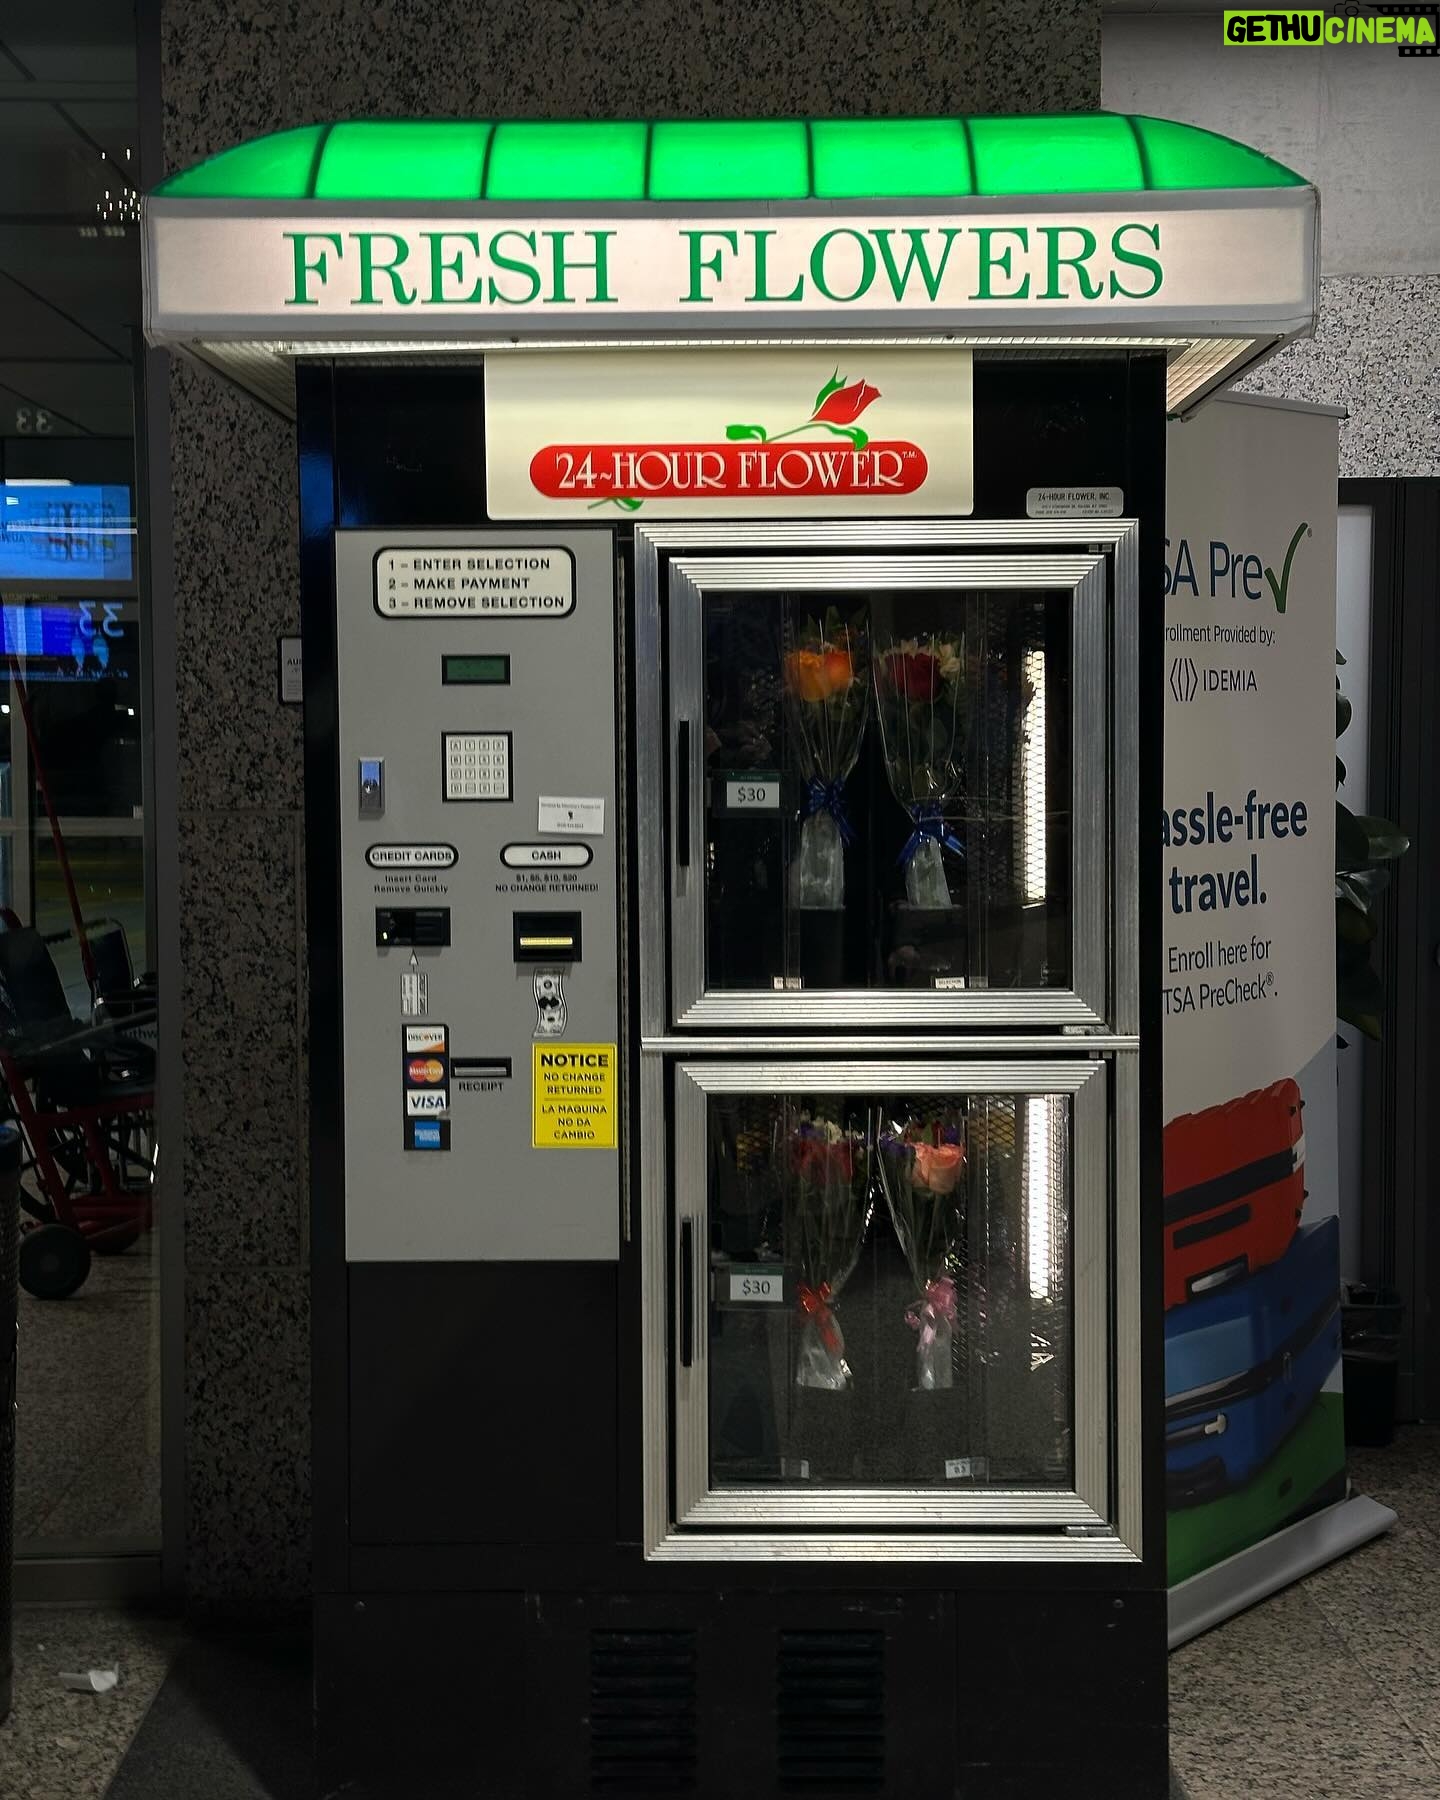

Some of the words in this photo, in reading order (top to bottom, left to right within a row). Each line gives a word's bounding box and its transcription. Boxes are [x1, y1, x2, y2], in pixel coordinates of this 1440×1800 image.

[283, 229, 618, 305] FRESH
[678, 223, 1164, 302] FLOWERS
[738, 449, 904, 491] FLOWER
[388, 558, 395, 570] 1
[413, 558, 462, 570] ENTER
[467, 557, 550, 570] SELECTION
[388, 578, 396, 590] 2
[413, 578, 456, 590] MAKE
[461, 577, 530, 590] PAYMENT
[388, 597, 396, 609] 3
[413, 597, 476, 609] REMOVE
[481, 596, 564, 609] SELECTION
[1214, 625, 1256, 643] Provided
[1260, 627, 1276, 646] by:
[1203, 670, 1258, 692] IDEMIA
[737, 785, 766, 803] $30
[372, 851, 412, 862] CREDIT
[414, 850, 453, 861] CARDS
[532, 850, 562, 861] CASH
[385, 874, 412, 883] Insert
[415, 874, 437, 883] Card
[563, 873, 578, 882] $20
[1168, 853, 1267, 914] travel.
[374, 885, 411, 894] Remove
[414, 884, 449, 895] Quickly
[495, 884, 508, 893] NO
[511, 884, 547, 893] CHANGE
[549, 884, 599, 893] RETURNED!
[1168, 941, 1213, 974] Enroll
[1218, 940, 1248, 967] here
[1251, 935, 1272, 962] for
[1163, 985, 1196, 1015] TSA
[540, 1054, 609, 1068] NOTICE
[543, 1072, 559, 1082] NO
[562, 1072, 605, 1082] CHANGE
[458, 1081, 504, 1092] RECEIPT
[547, 1085, 602, 1095] RETURNED
[410, 1095, 445, 1109] VISA
[542, 1105, 556, 1114] LA
[558, 1104, 607, 1114] MAQUINA
[558, 1118, 574, 1127] NO
[576, 1118, 591, 1127] DA
[553, 1131, 596, 1140] CAMBIO
[742, 1279, 771, 1297] $30
